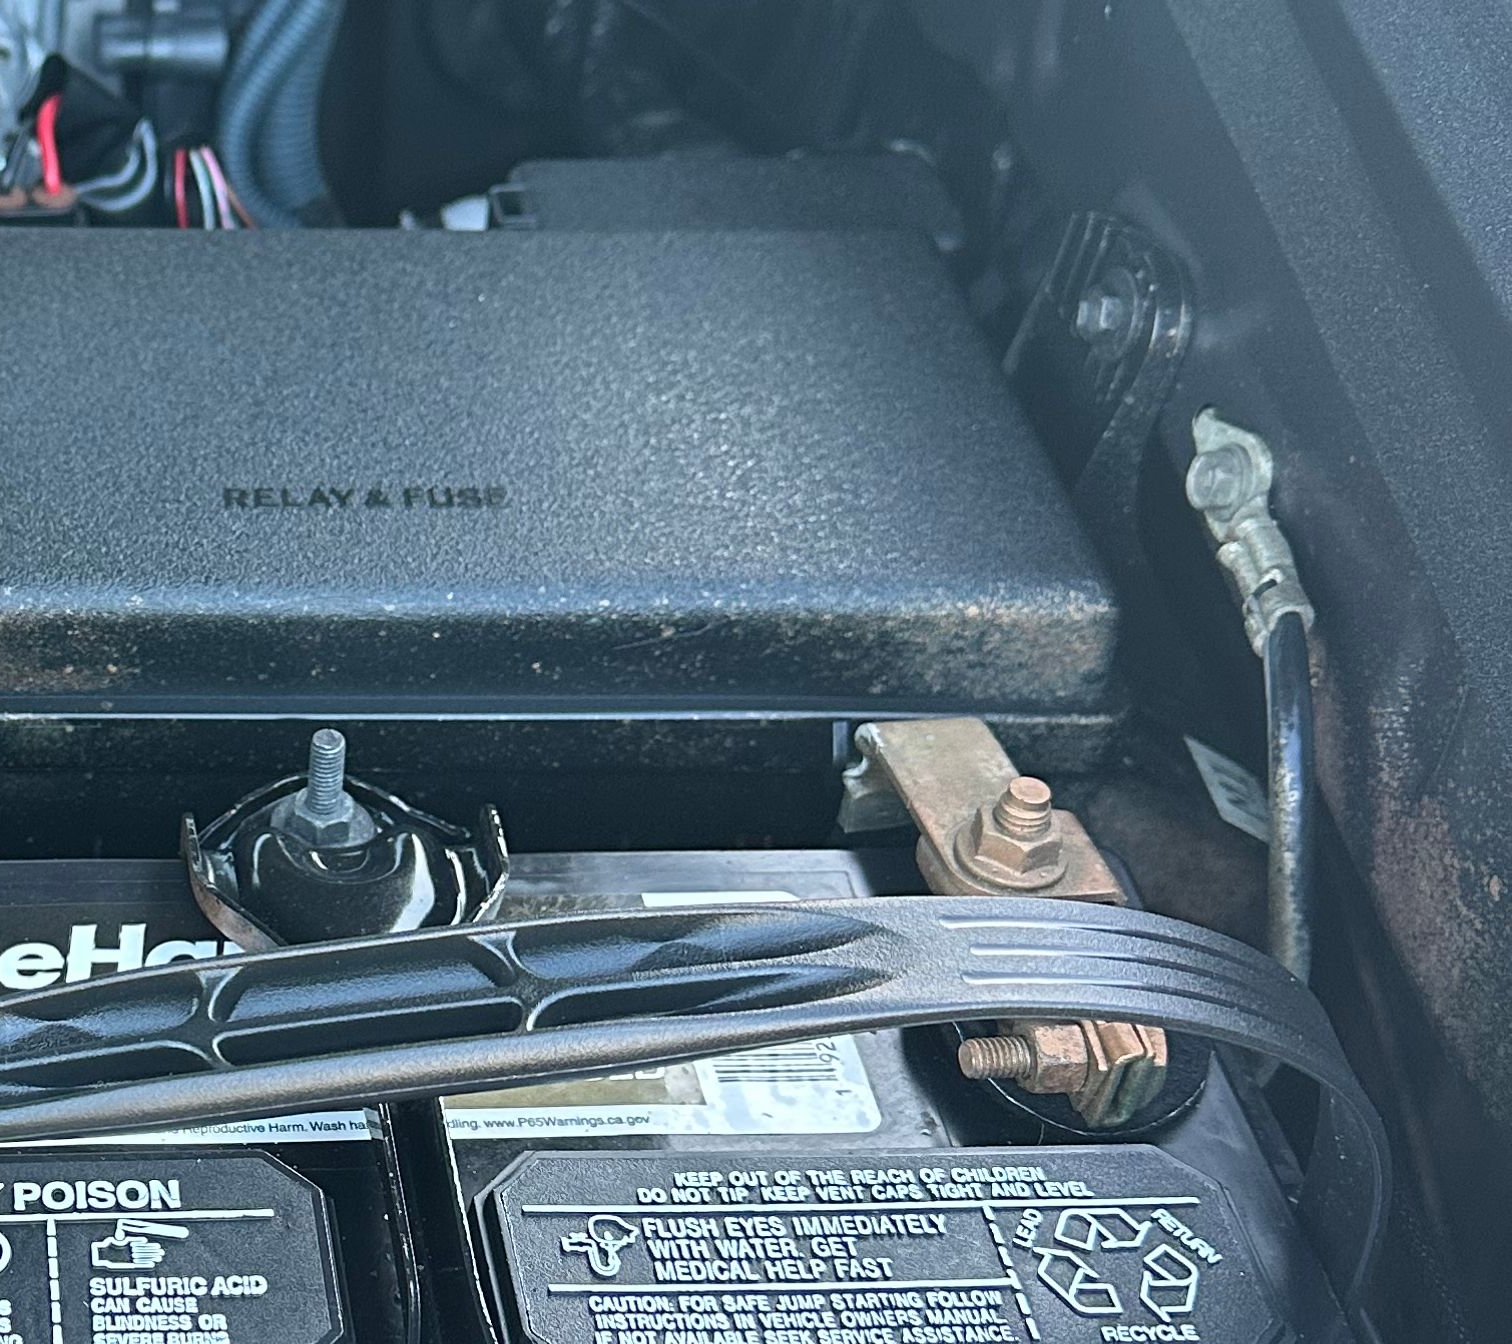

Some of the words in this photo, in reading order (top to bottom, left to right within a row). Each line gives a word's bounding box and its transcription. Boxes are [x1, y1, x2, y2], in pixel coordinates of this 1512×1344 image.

[223, 486, 353, 509] RELAY
[364, 486, 389, 508] &
[403, 486, 508, 508] FUSE
[268, 1122, 308, 1132] Harm.
[309, 1120, 346, 1132] Wash
[673, 1171, 723, 1187] KEEP
[728, 1170, 768, 1187] OUT
[773, 1170, 801, 1186] OF
[805, 1169, 847, 1186] THE
[850, 1168, 916, 1185] REACH
[919, 1167, 948, 1183] OF
[950, 1166, 1047, 1182] CHILDREN
[13, 1179, 181, 1211] POISON
[637, 1187, 667, 1204] DO
[671, 1187, 711, 1203] NOT
[760, 1186, 811, 1202] KEEP
[815, 1185, 865, 1202] VENT
[871, 1184, 923, 1201] CAPS
[926, 1183, 982, 1200] TIGHT
[991, 1182, 1032, 1198] AND
[1034, 1181, 1095, 1197] LEVEL
[640, 1216, 718, 1239] FLUSH
[723, 1216, 785, 1237] EYES
[790, 1214, 948, 1237] IMMEDIATELY
[1012, 1208, 1043, 1248] LEAD
[1150, 1208, 1223, 1264] RETURN
[647, 1239, 712, 1260] WITH
[715, 1238, 804, 1259] WATER.
[810, 1237, 858, 1258] GET
[654, 1259, 760, 1281] MEDICAL
[764, 1258, 827, 1280] HELP
[833, 1257, 893, 1278] FAST
[89, 1276, 208, 1296] SULFURIC
[211, 1275, 268, 1296] ACID
[90, 1297, 130, 1314] CAN
[135, 1296, 198, 1314] CAUSE
[588, 1294, 675, 1313] CAUTION:
[678, 1295, 718, 1312] FOR
[721, 1294, 770, 1312] SAFE
[776, 1293, 826, 1311] JUMP
[830, 1292, 926, 1310] STARTING
[926, 1290, 1002, 1308] FOLLOW
[92, 1314, 192, 1332] BLINDNESS
[197, 1313, 228, 1331] OR
[594, 1312, 729, 1330] INSTRUCTIONS
[733, 1312, 756, 1329] IN
[758, 1311, 837, 1329] VEHICLE
[840, 1309, 923, 1328] OWNERS
[902, 1325, 1019, 1344] ASSISTANCE.
[1100, 1324, 1200, 1342] RECYCLE
